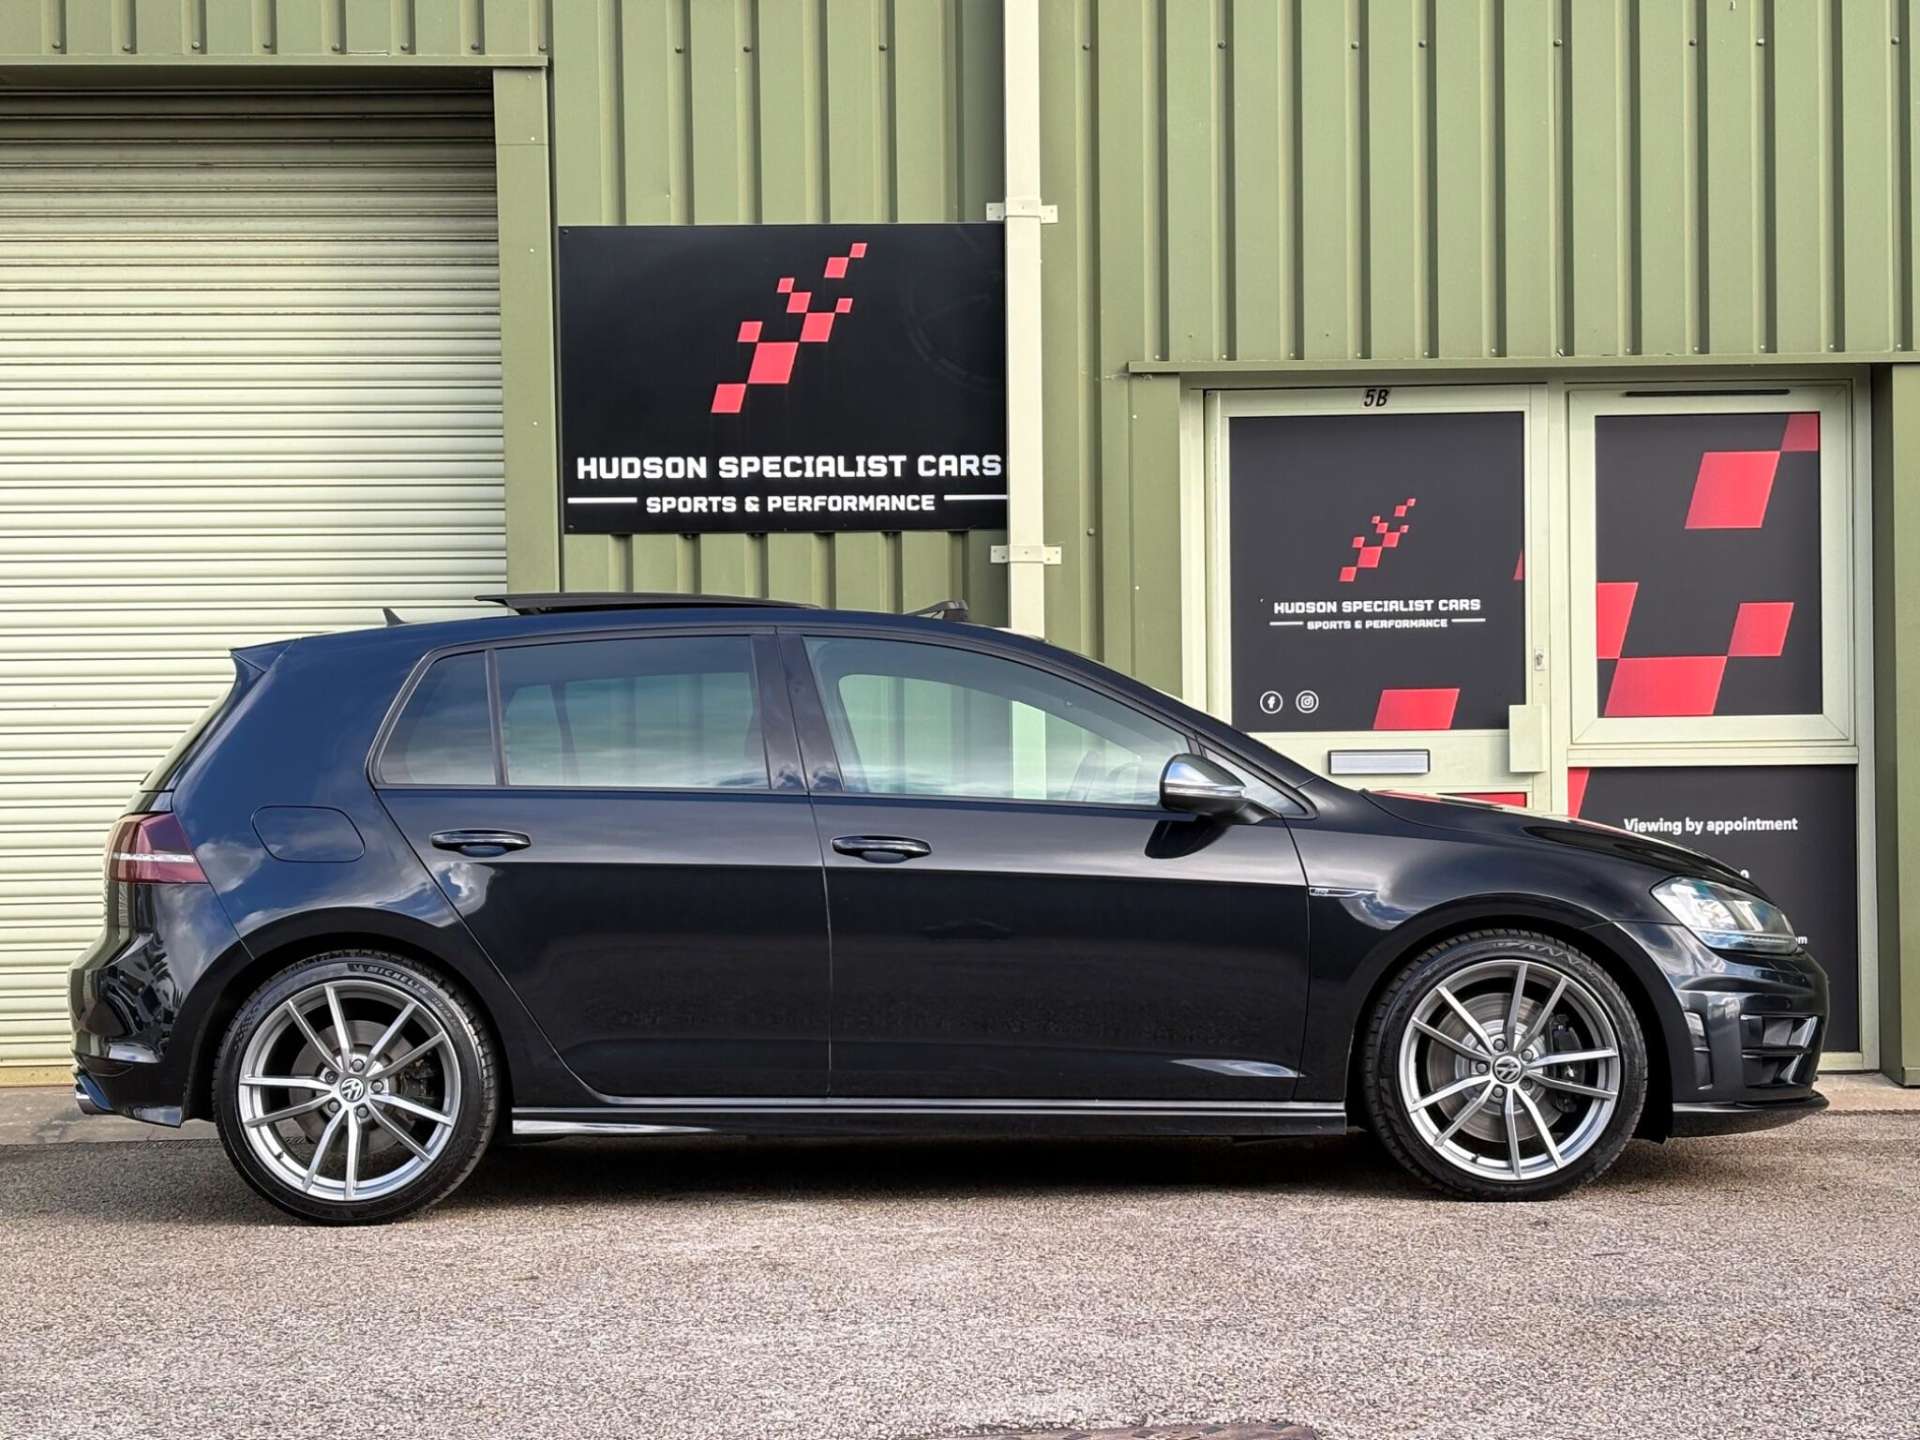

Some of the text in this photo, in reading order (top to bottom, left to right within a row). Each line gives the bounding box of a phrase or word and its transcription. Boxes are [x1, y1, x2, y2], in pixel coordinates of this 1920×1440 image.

[1364, 388, 1389, 407] 5B
[577, 454, 1002, 480] HUDSON SPECIALIST CARS
[646, 494, 936, 514] SPORTS & PERFORMANCE
[1273, 598, 1482, 615] HUDSON SPECIALIST CARS
[1306, 618, 1448, 631] SPORTS & PERFORMANCE
[1624, 817, 1798, 835] Viewing by appointment
[367, 966, 428, 994] MICHELIN
